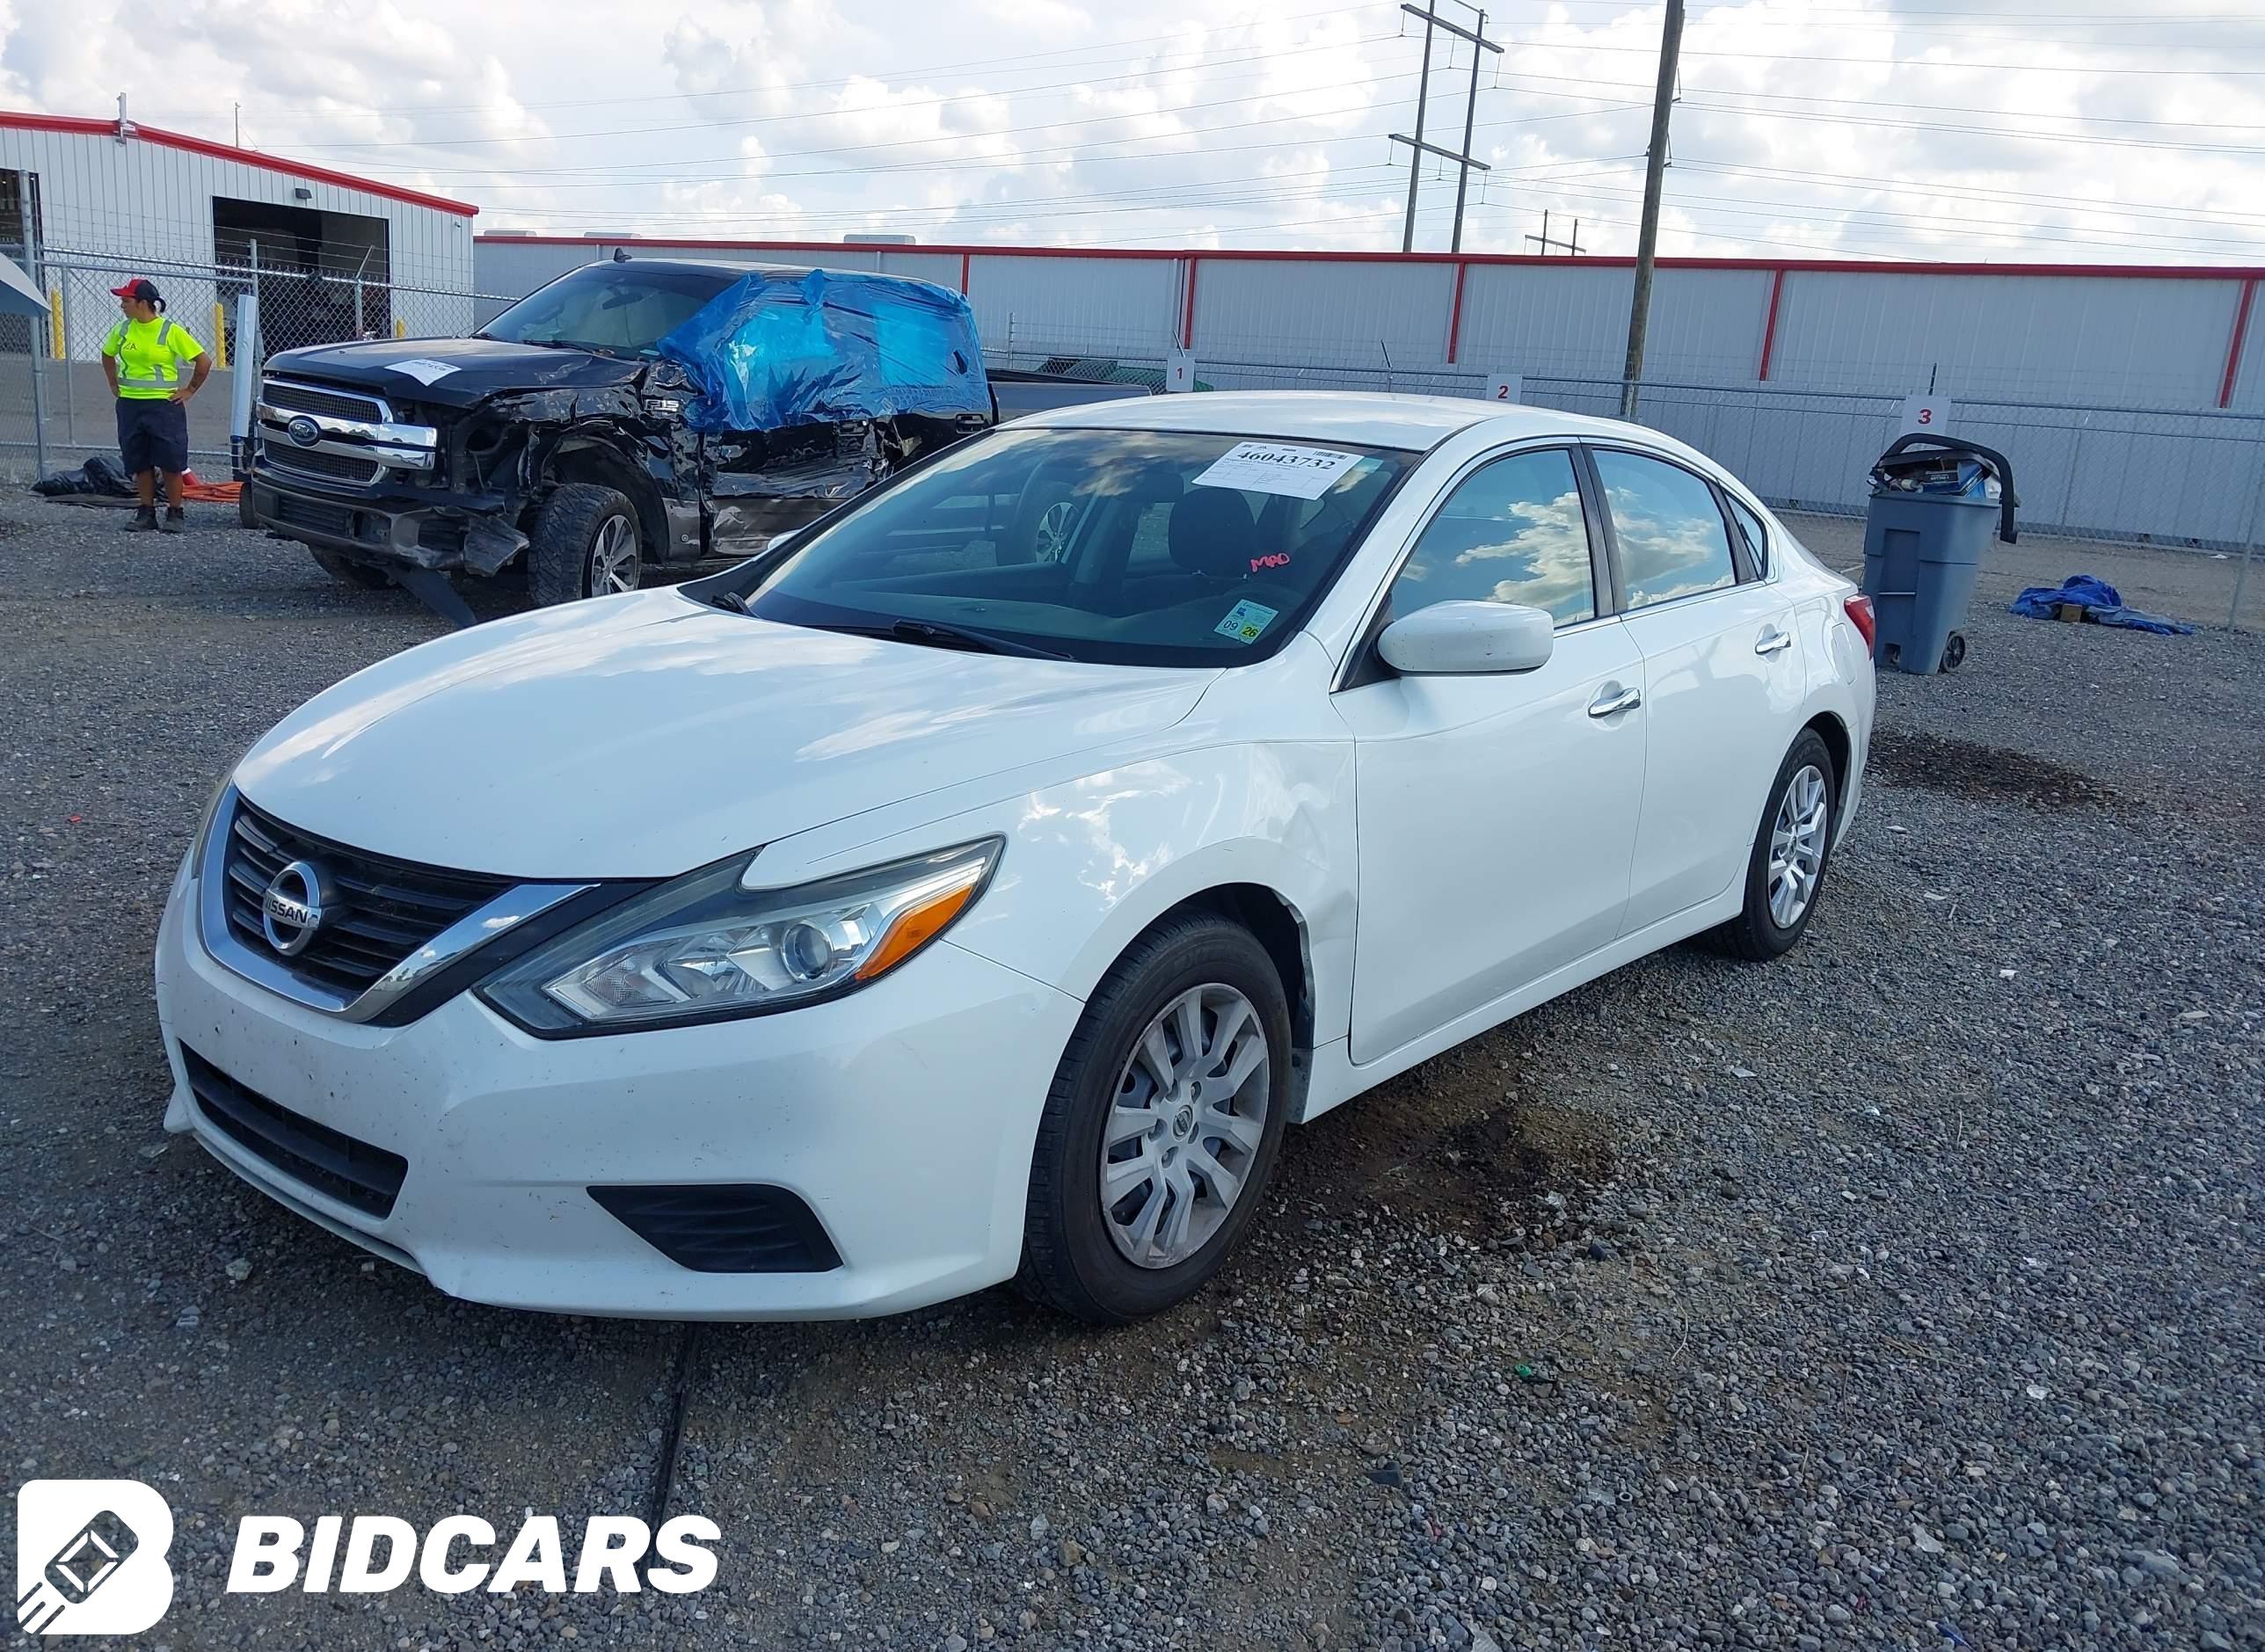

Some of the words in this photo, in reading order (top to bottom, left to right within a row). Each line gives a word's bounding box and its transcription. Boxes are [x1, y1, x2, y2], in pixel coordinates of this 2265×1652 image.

[1176, 367, 1183, 380] 1
[1497, 385, 1509, 399] 2
[1917, 408, 1932, 425] 3
[1237, 451, 1336, 470] 46043732
[1223, 620, 1239, 631] 09
[1242, 626, 1259, 637] 26
